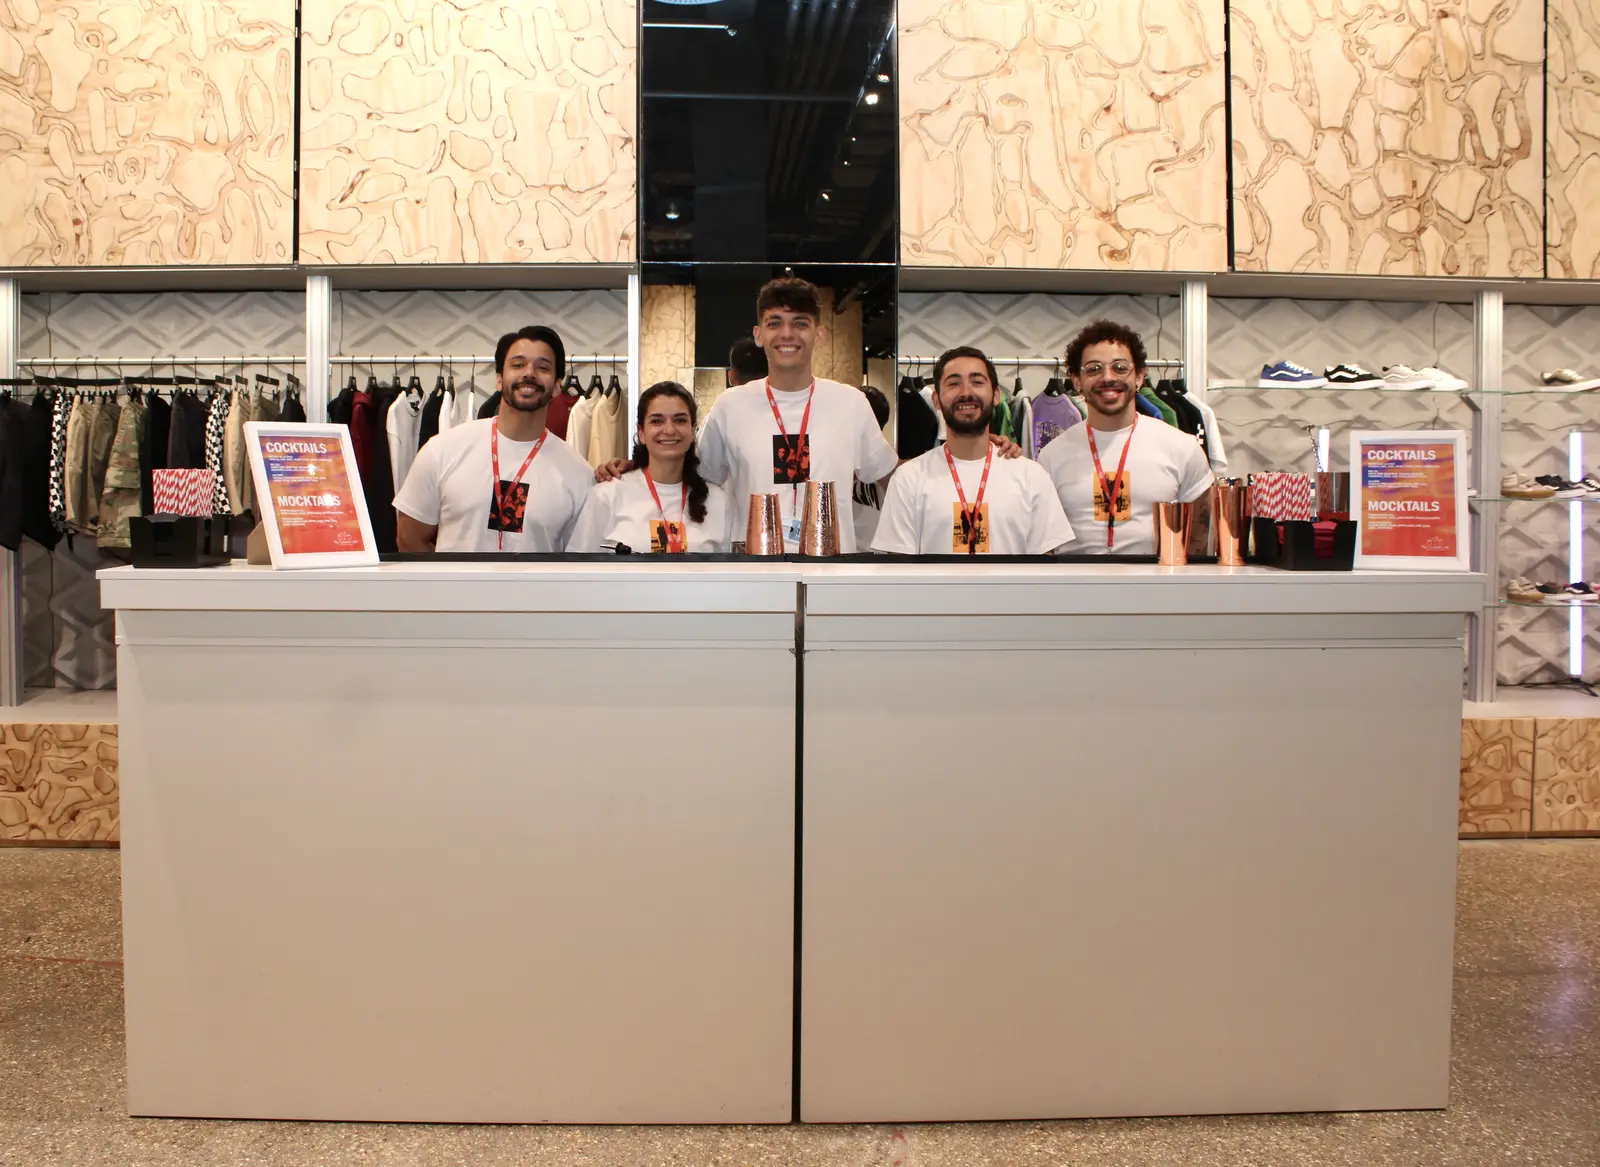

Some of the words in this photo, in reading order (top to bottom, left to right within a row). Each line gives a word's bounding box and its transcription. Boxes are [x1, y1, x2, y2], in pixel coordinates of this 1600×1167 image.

[265, 441, 327, 454] COCKTAILS
[1367, 449, 1437, 460] COCKTAILS
[277, 495, 341, 507] MOCKTAS
[1367, 500, 1440, 512] MOCKTAILS
